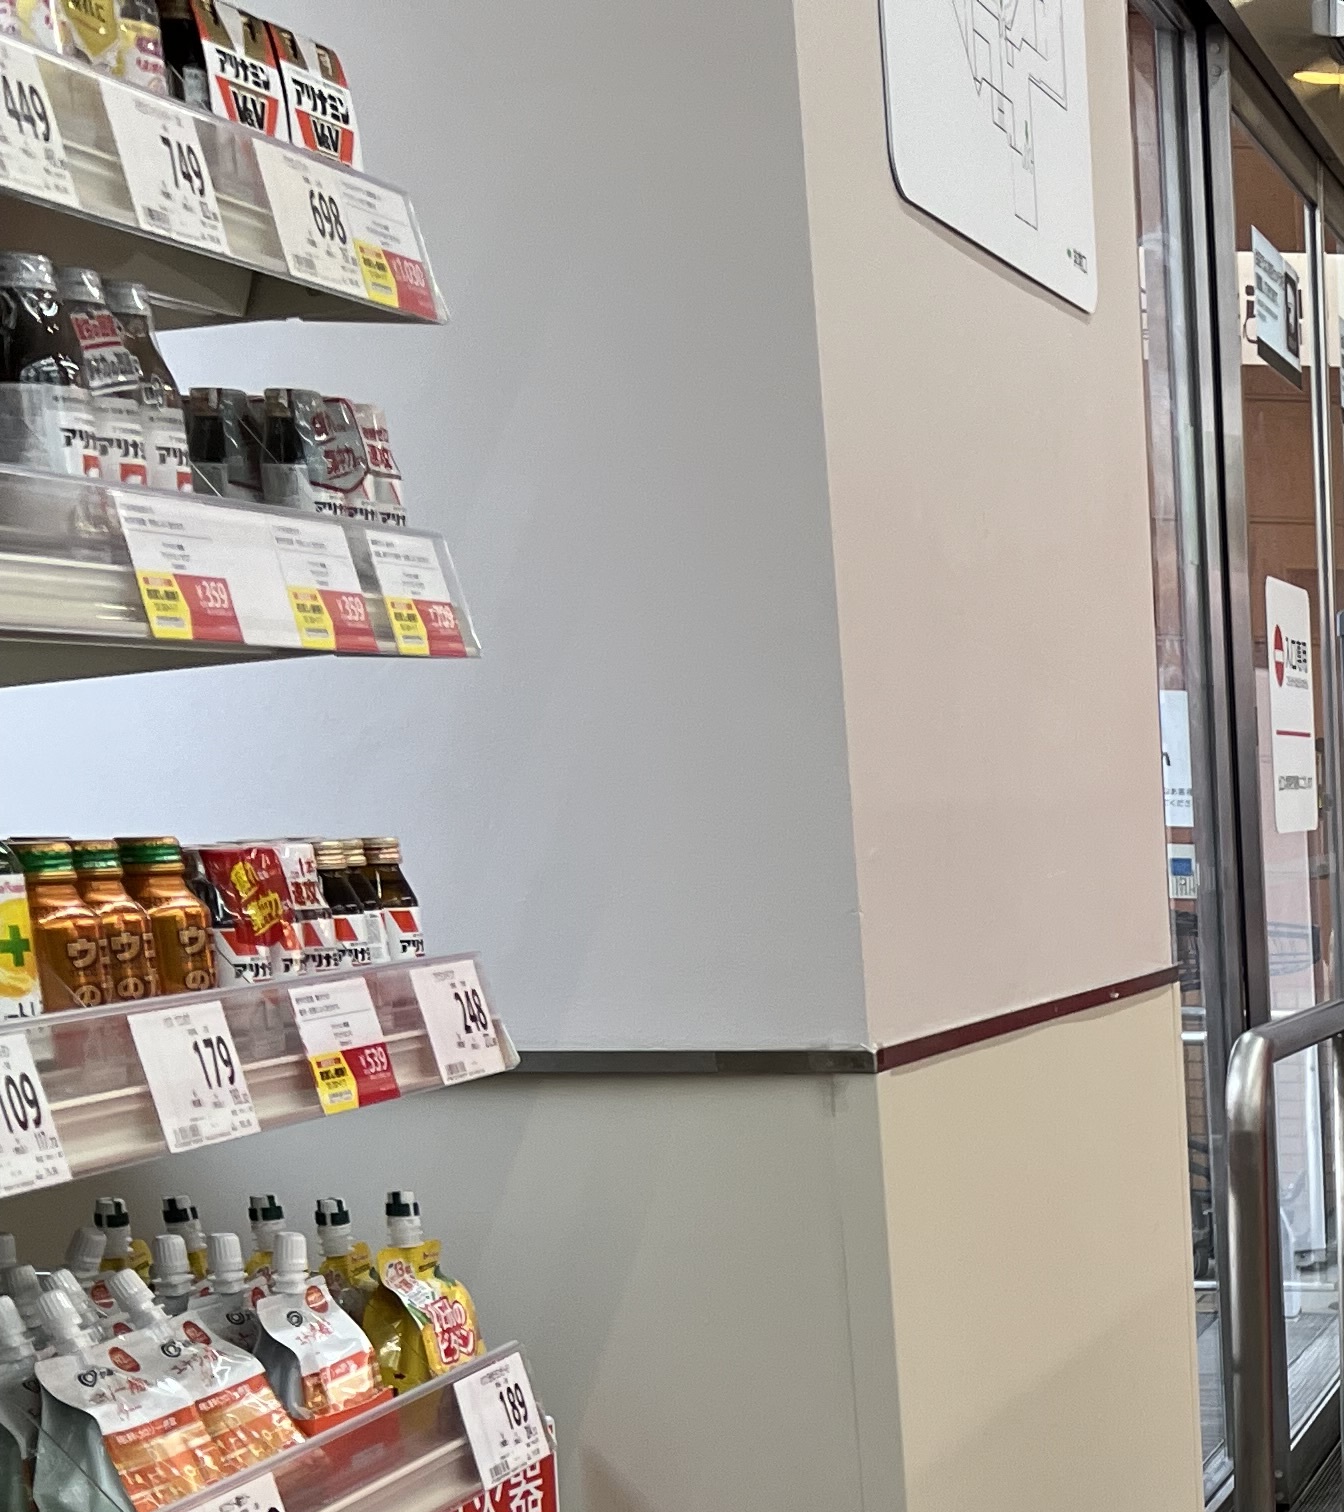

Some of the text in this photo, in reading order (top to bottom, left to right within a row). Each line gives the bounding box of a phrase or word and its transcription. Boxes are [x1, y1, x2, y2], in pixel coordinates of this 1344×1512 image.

[2, 74, 50, 142] 449
[291, 77, 351, 126] アリナミン
[159, 134, 206, 197] 749
[308, 188, 348, 246] 698
[454, 986, 491, 1036] 248
[192, 1034, 236, 1090] 179
[498, 1382, 529, 1431] 189
